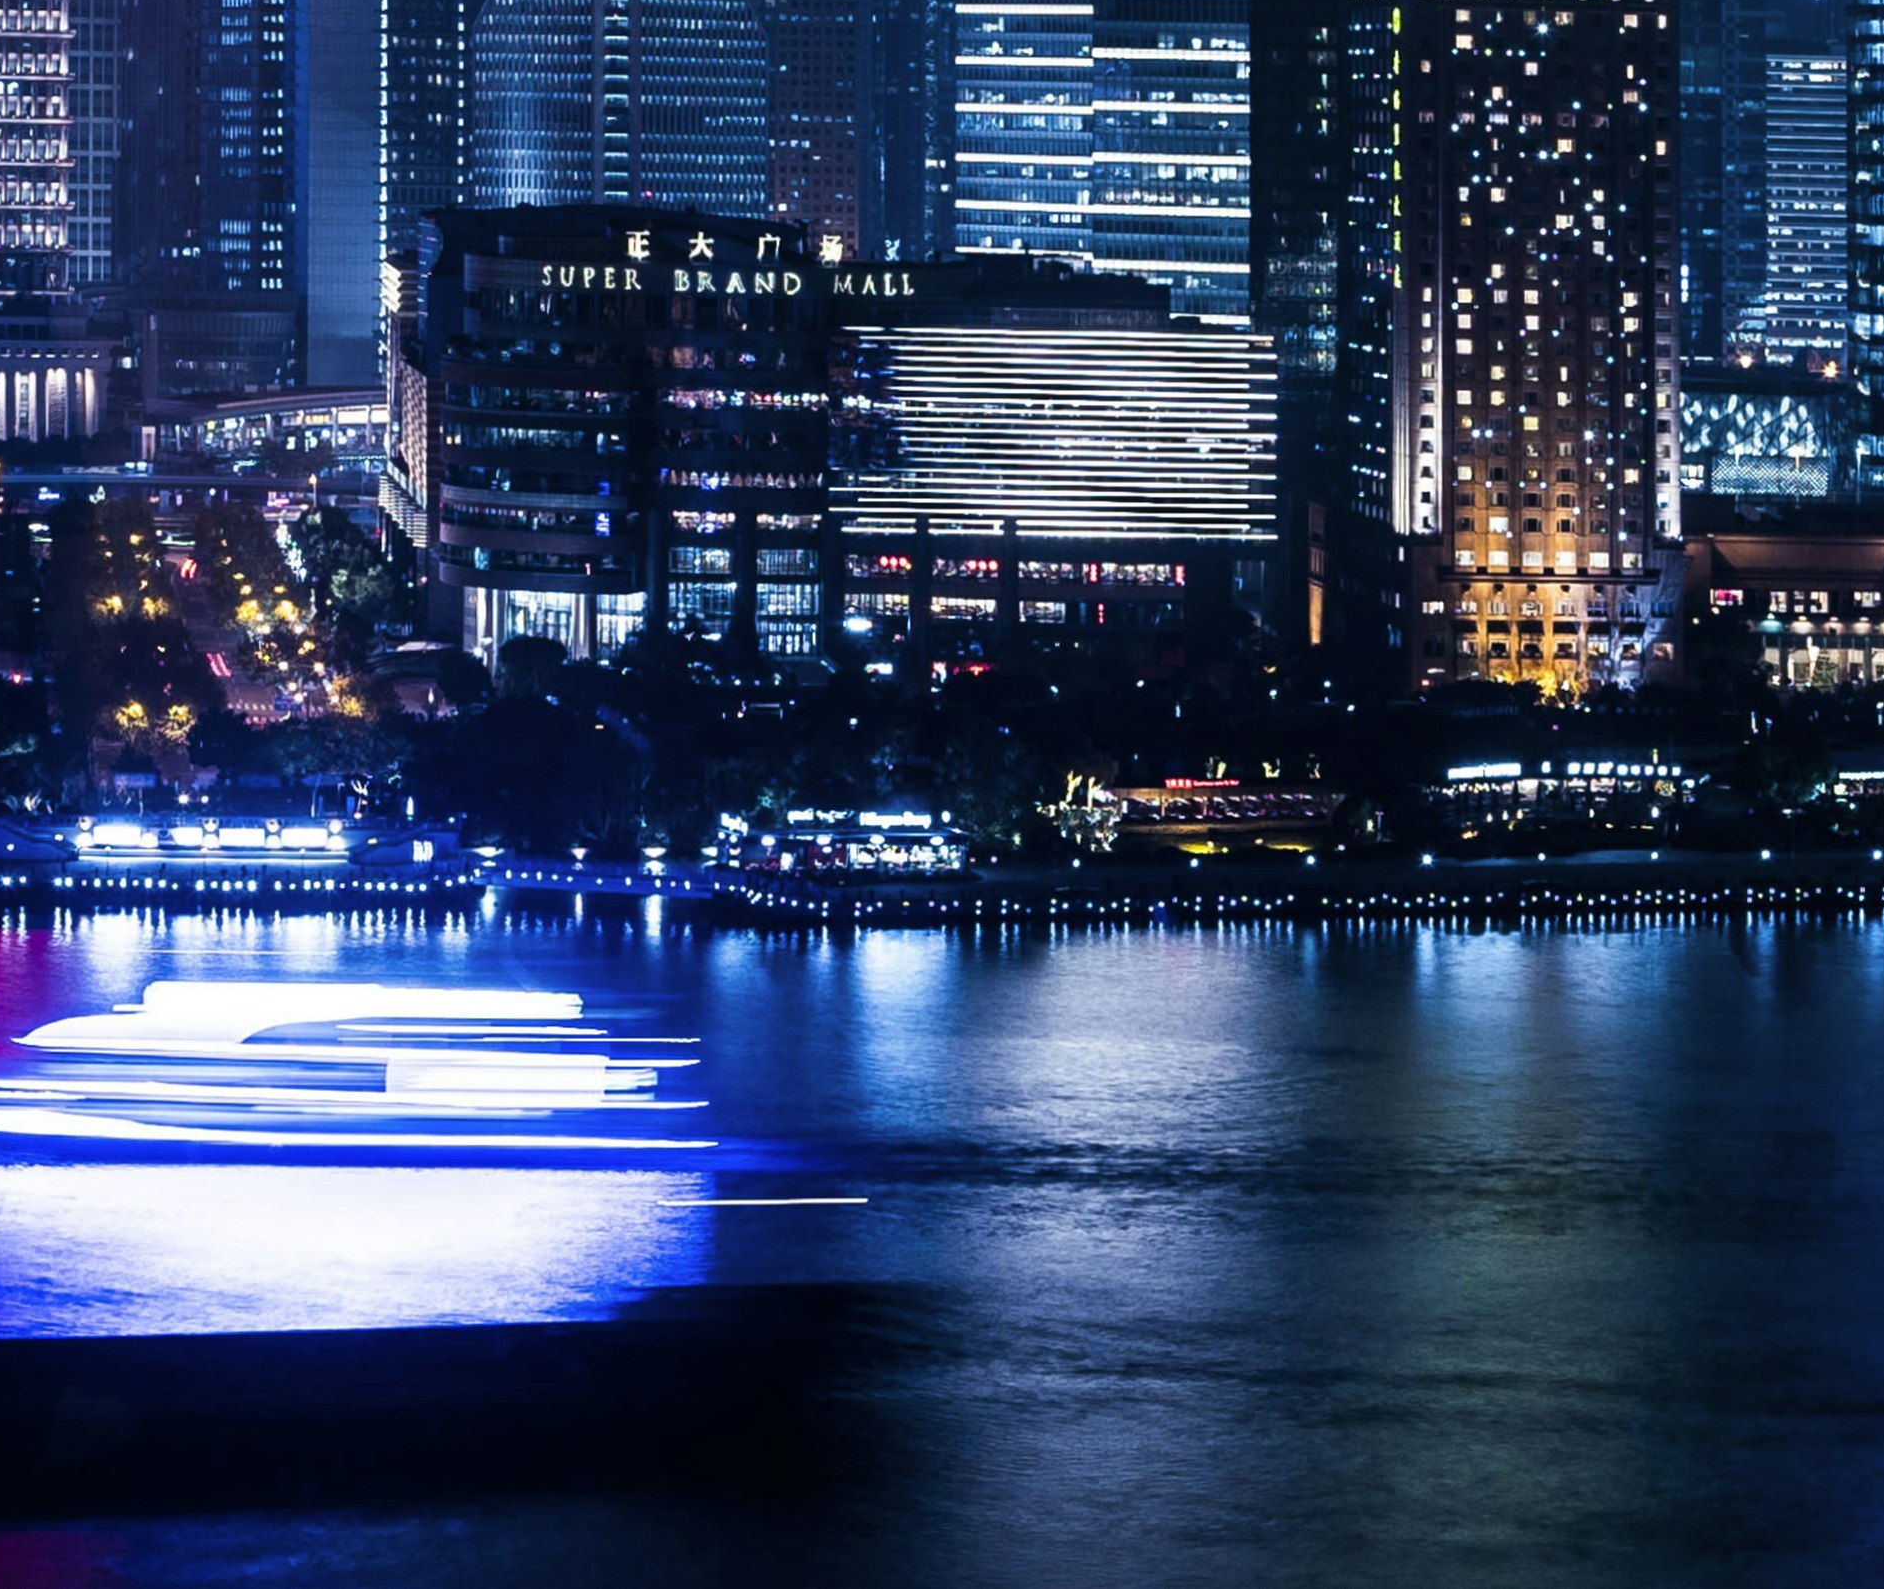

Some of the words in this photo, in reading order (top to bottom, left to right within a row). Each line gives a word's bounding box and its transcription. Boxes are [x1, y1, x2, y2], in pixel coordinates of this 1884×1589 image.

[627, 230, 844, 263] 正大广场
[542, 266, 642, 291] SUPER
[674, 269, 802, 296] BRAND
[834, 274, 915, 296] MALL
